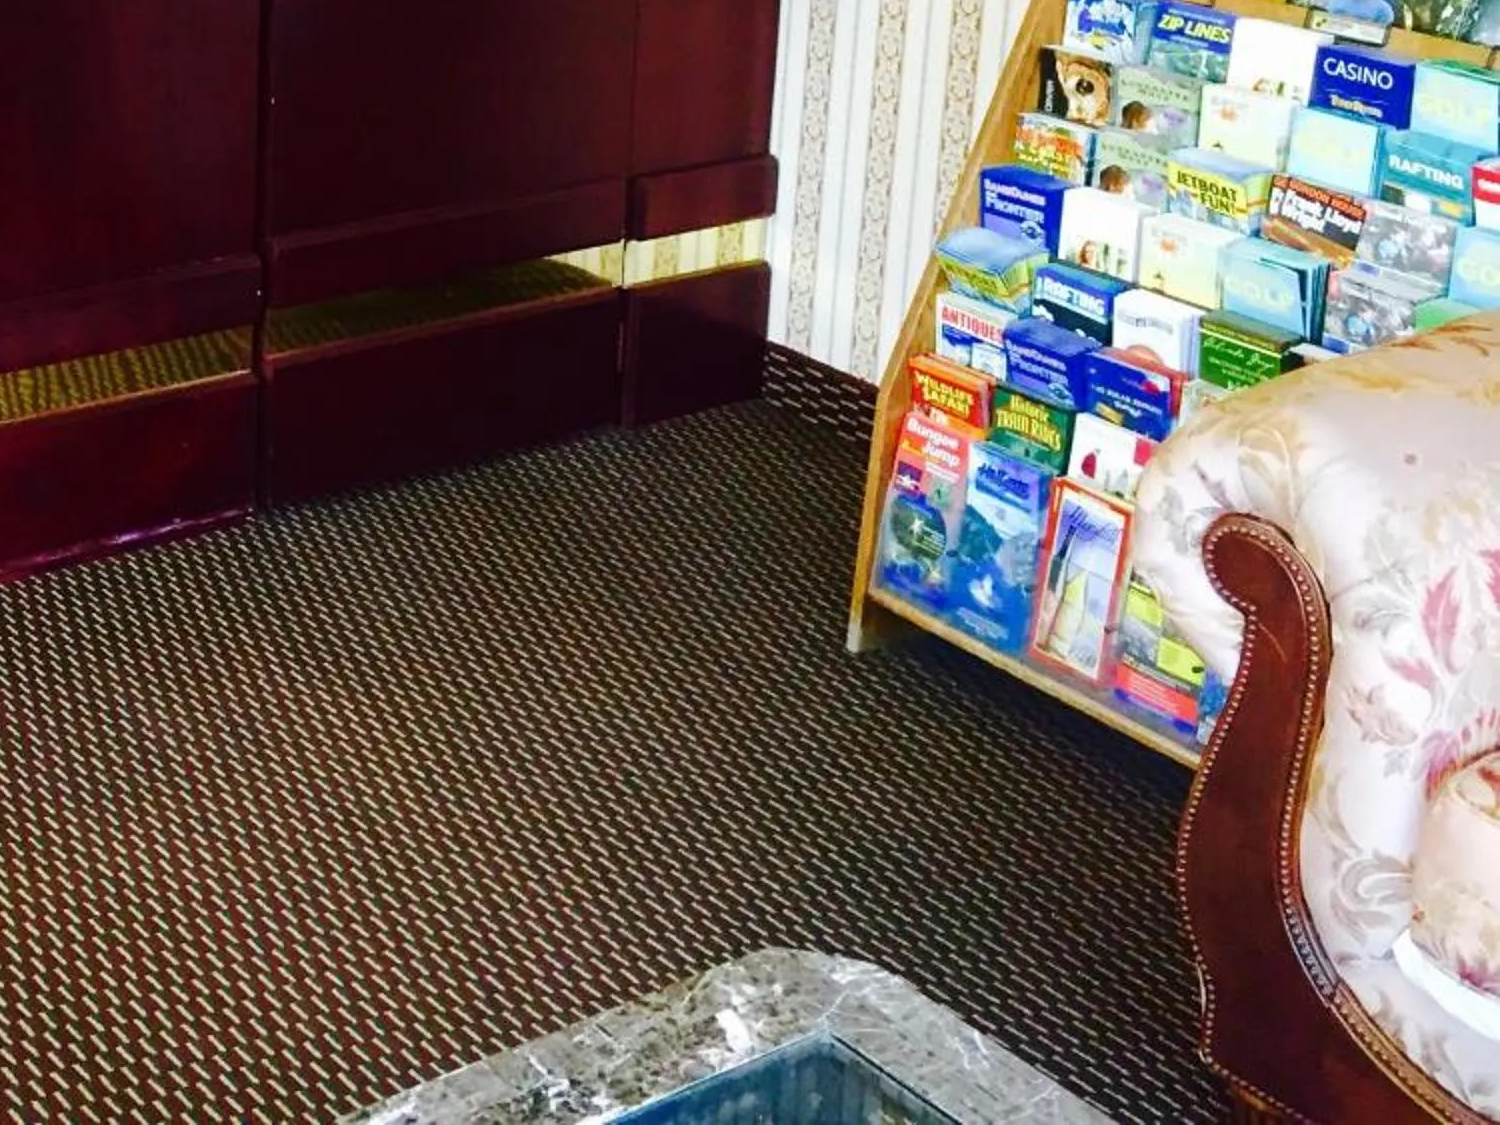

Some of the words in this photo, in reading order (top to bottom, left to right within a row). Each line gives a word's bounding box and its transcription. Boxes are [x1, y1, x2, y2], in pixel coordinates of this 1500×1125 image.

[1157, 13, 1187, 32] ZIP
[1184, 20, 1232, 44] LINES
[1323, 58, 1394, 90] CASINO
[1176, 170, 1238, 203] JETBOAT
[1387, 155, 1466, 190] RAFTING
[1043, 276, 1106, 316] RAFTING
[941, 306, 1005, 345] ANTIQUES
[907, 417, 960, 450] Bungee
[996, 408, 1030, 434] TRAIN
[921, 442, 960, 468] Jump
